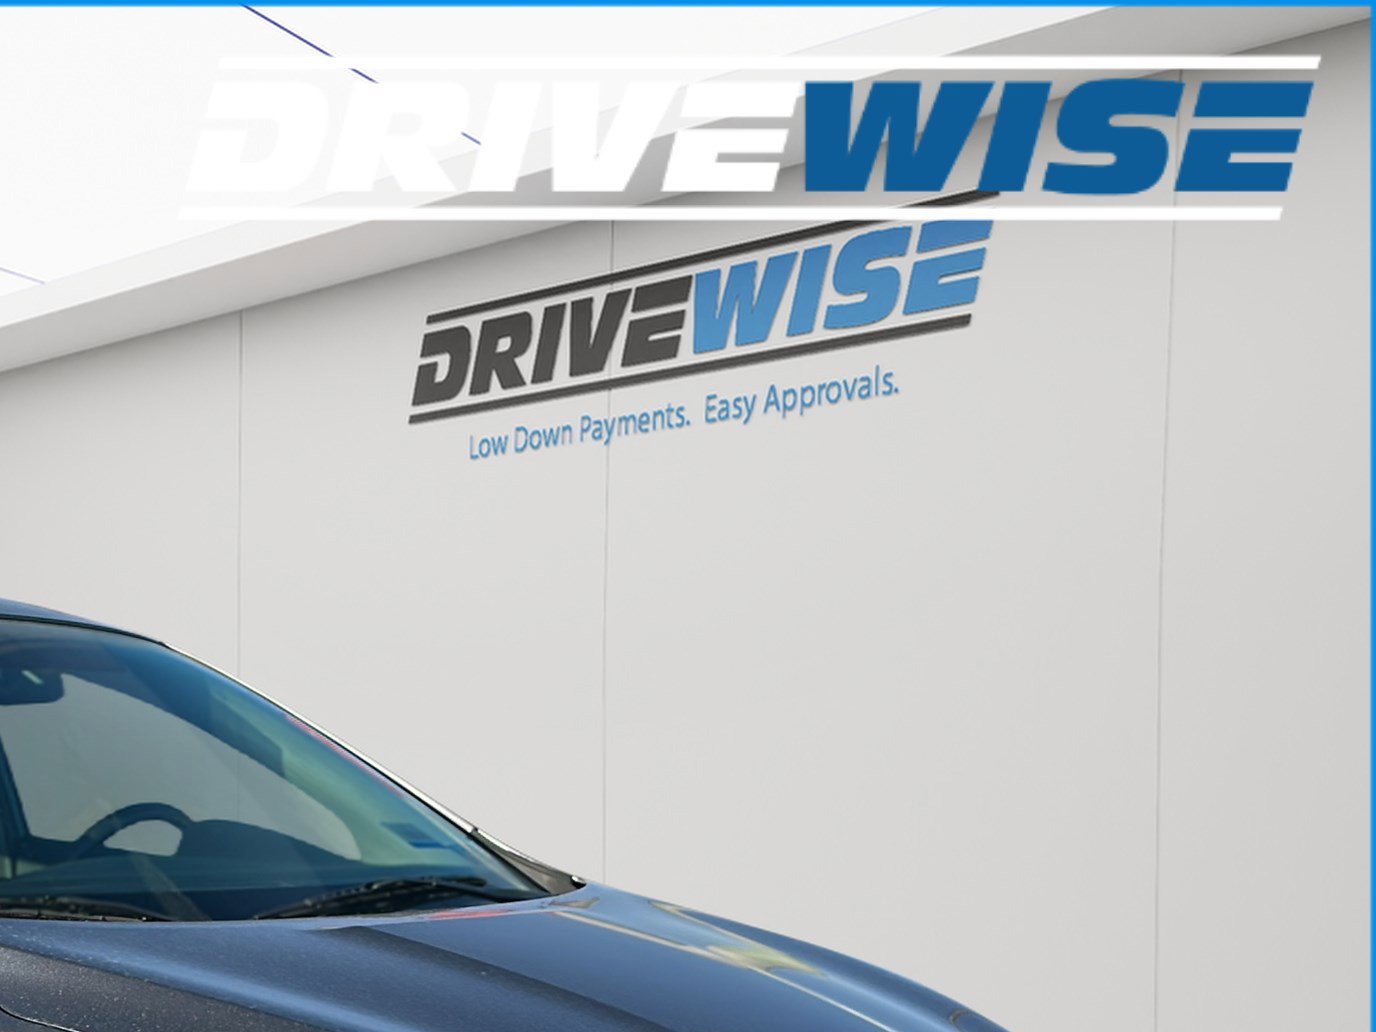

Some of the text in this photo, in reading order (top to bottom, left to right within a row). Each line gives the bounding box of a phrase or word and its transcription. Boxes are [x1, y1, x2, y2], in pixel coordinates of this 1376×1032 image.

[412, 219, 994, 406] DRIVEWISE
[469, 365, 900, 459] Low Down Payments. Easy Approvals.
